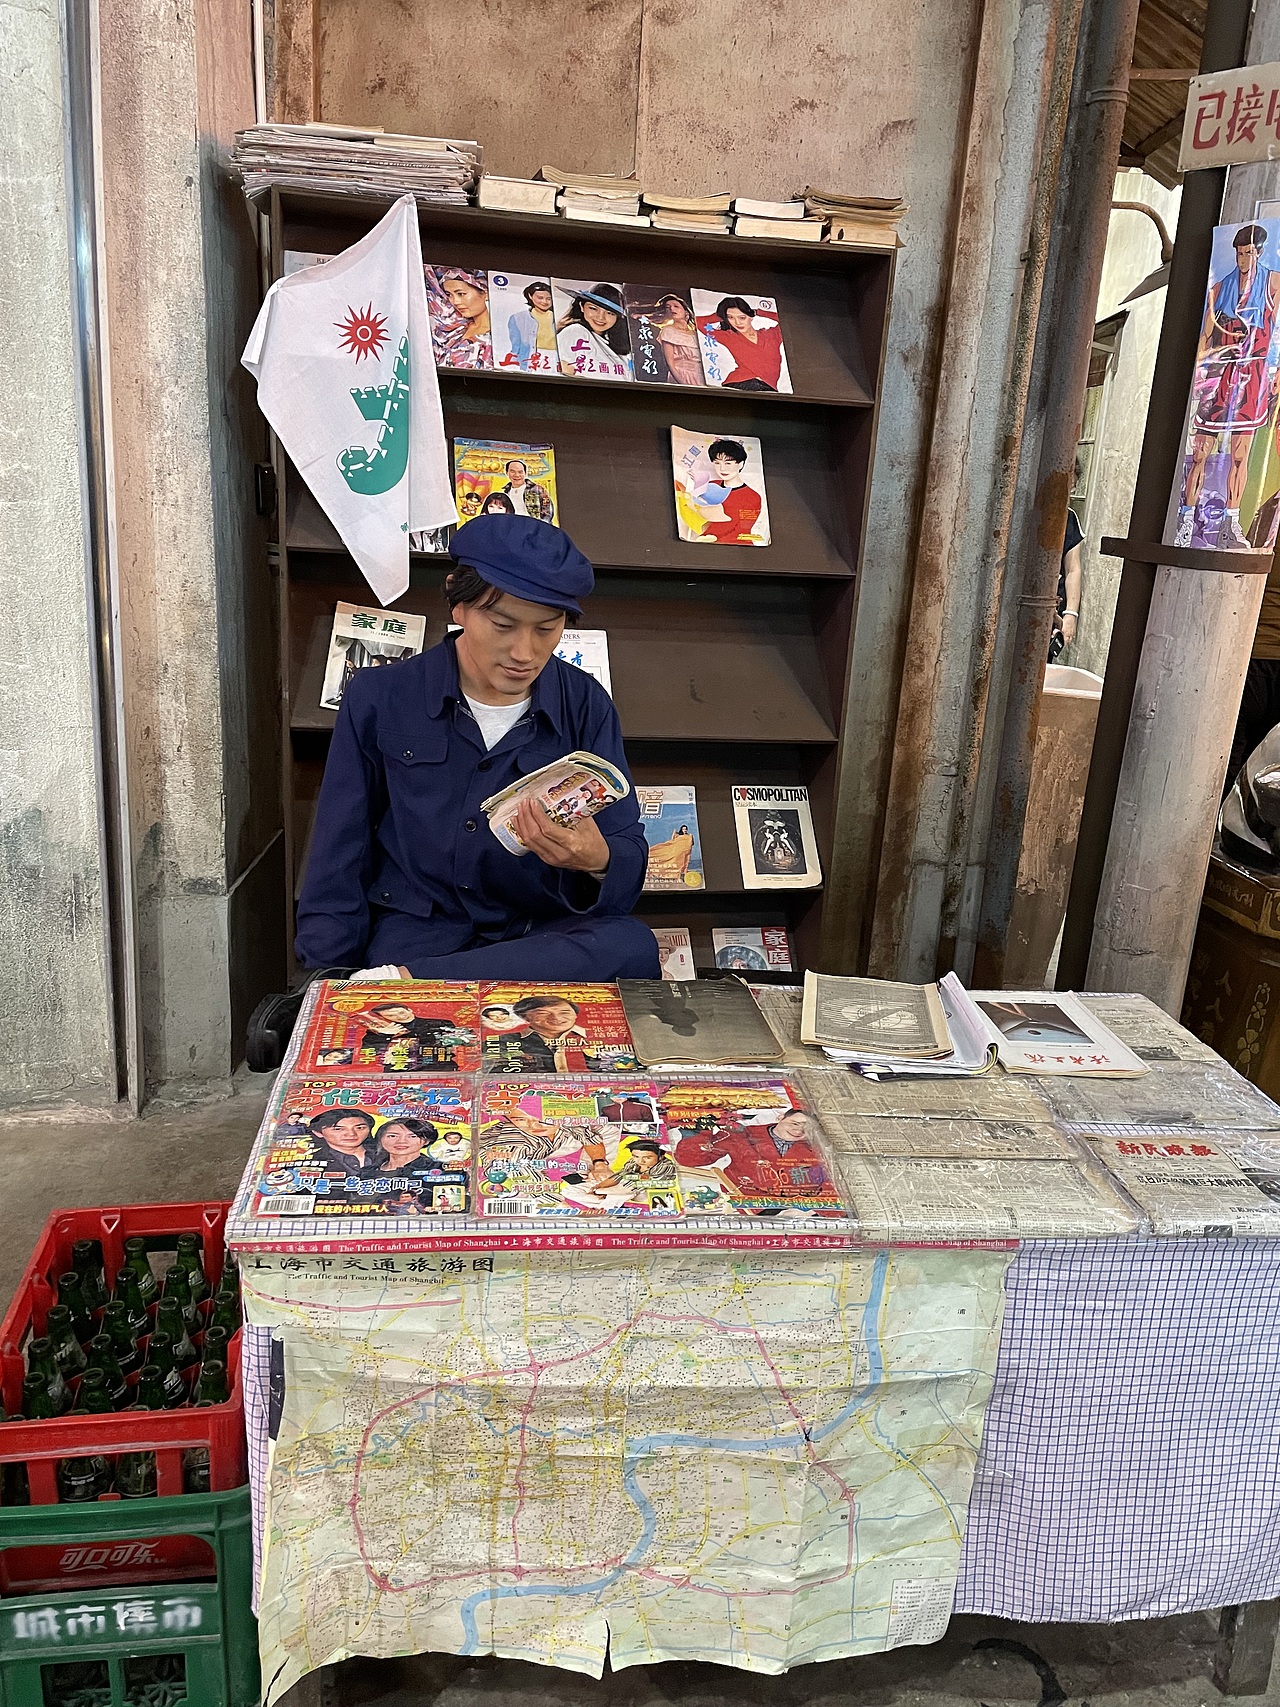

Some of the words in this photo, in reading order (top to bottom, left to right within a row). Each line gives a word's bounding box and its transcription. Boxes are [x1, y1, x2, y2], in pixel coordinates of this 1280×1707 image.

[351, 612, 408, 635] 家庭
[764, 929, 790, 965] 家庭
[498, 1083, 530, 1091] TOP
[1115, 1139, 1219, 1157] 新民晚报
[338, 1244, 354, 1252] The
[356, 1243, 385, 1252] Traffic
[386, 1243, 402, 1251] and
[403, 1241, 432, 1250] Tourist
[435, 1240, 451, 1249] Map
[453, 1240, 461, 1248] of
[463, 1239, 501, 1248] Shanghai
[510, 1236, 603, 1247] 上海市交通旅游图
[611, 1238, 626, 1246] The
[656, 1238, 670, 1246] and
[671, 1237, 699, 1246] Tourist
[701, 1237, 717, 1246] Map
[719, 1236, 727, 1245] of
[729, 1237, 764, 1247] Shanghai
[973, 1238, 1007, 1248] Shanghai
[247, 1256, 495, 1273] 上海市交通旅游图
[304, 1272, 332, 1280] Traffic
[334, 1273, 348, 1281] and
[350, 1274, 378, 1282] Tourist
[380, 1274, 397, 1283] Map
[400, 1275, 408, 1283] of
[60, 1540, 161, 1573] 可口可乐
